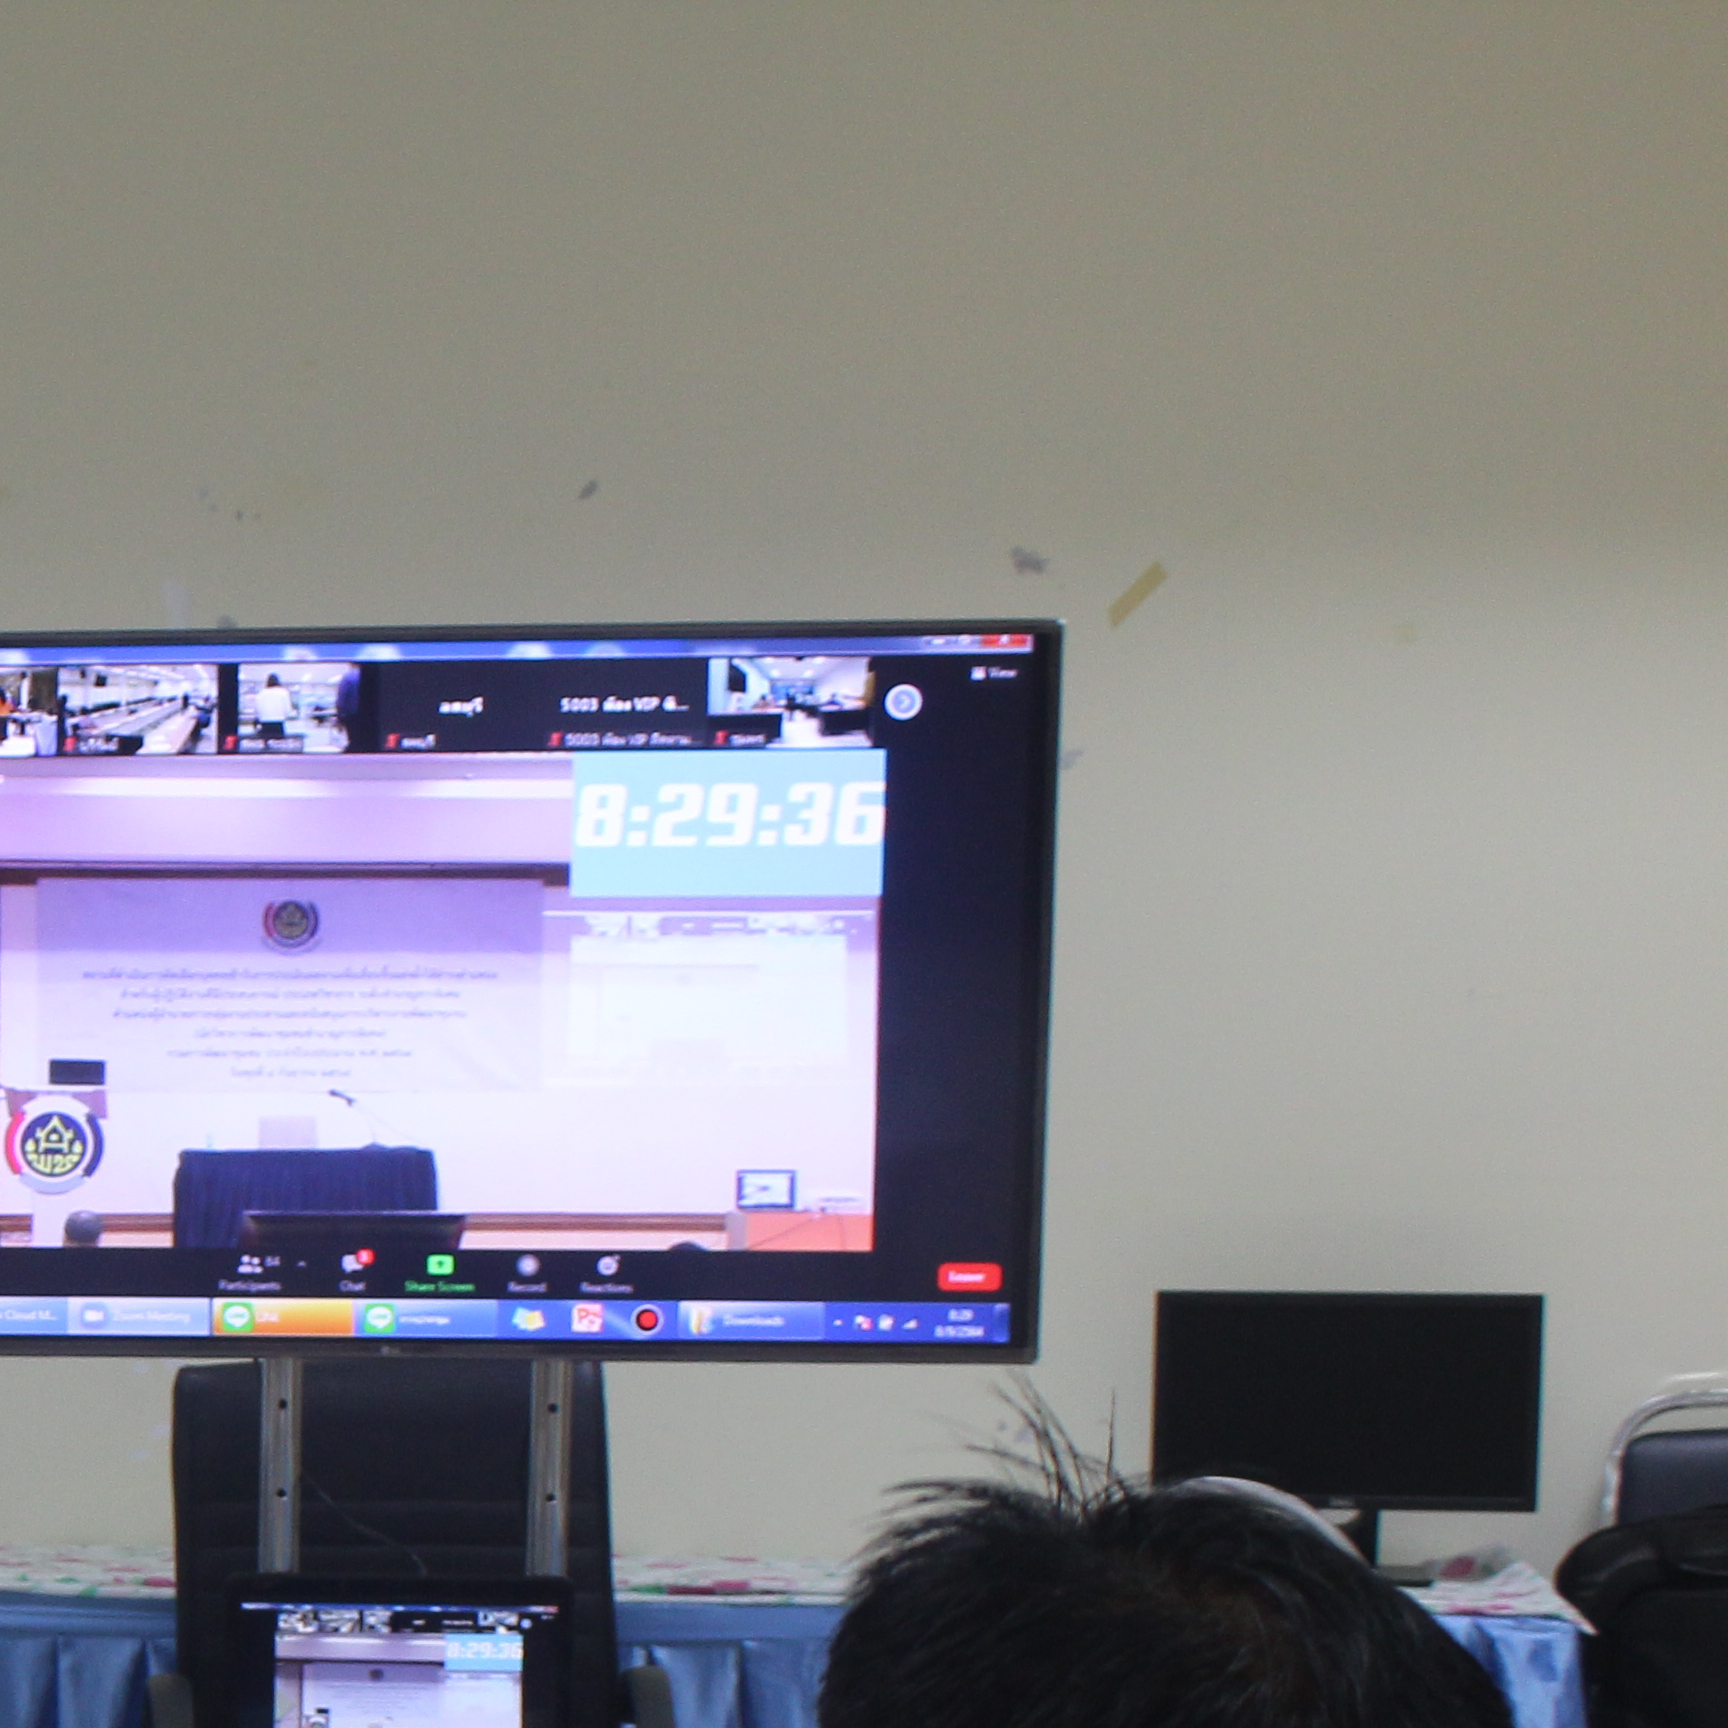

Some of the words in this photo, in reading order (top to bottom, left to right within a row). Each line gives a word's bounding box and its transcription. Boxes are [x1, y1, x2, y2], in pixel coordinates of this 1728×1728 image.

[575, 781, 886, 848] 8:29:36
[404, 1280, 439, 1292] Share
[440, 1281, 476, 1293] Screen
